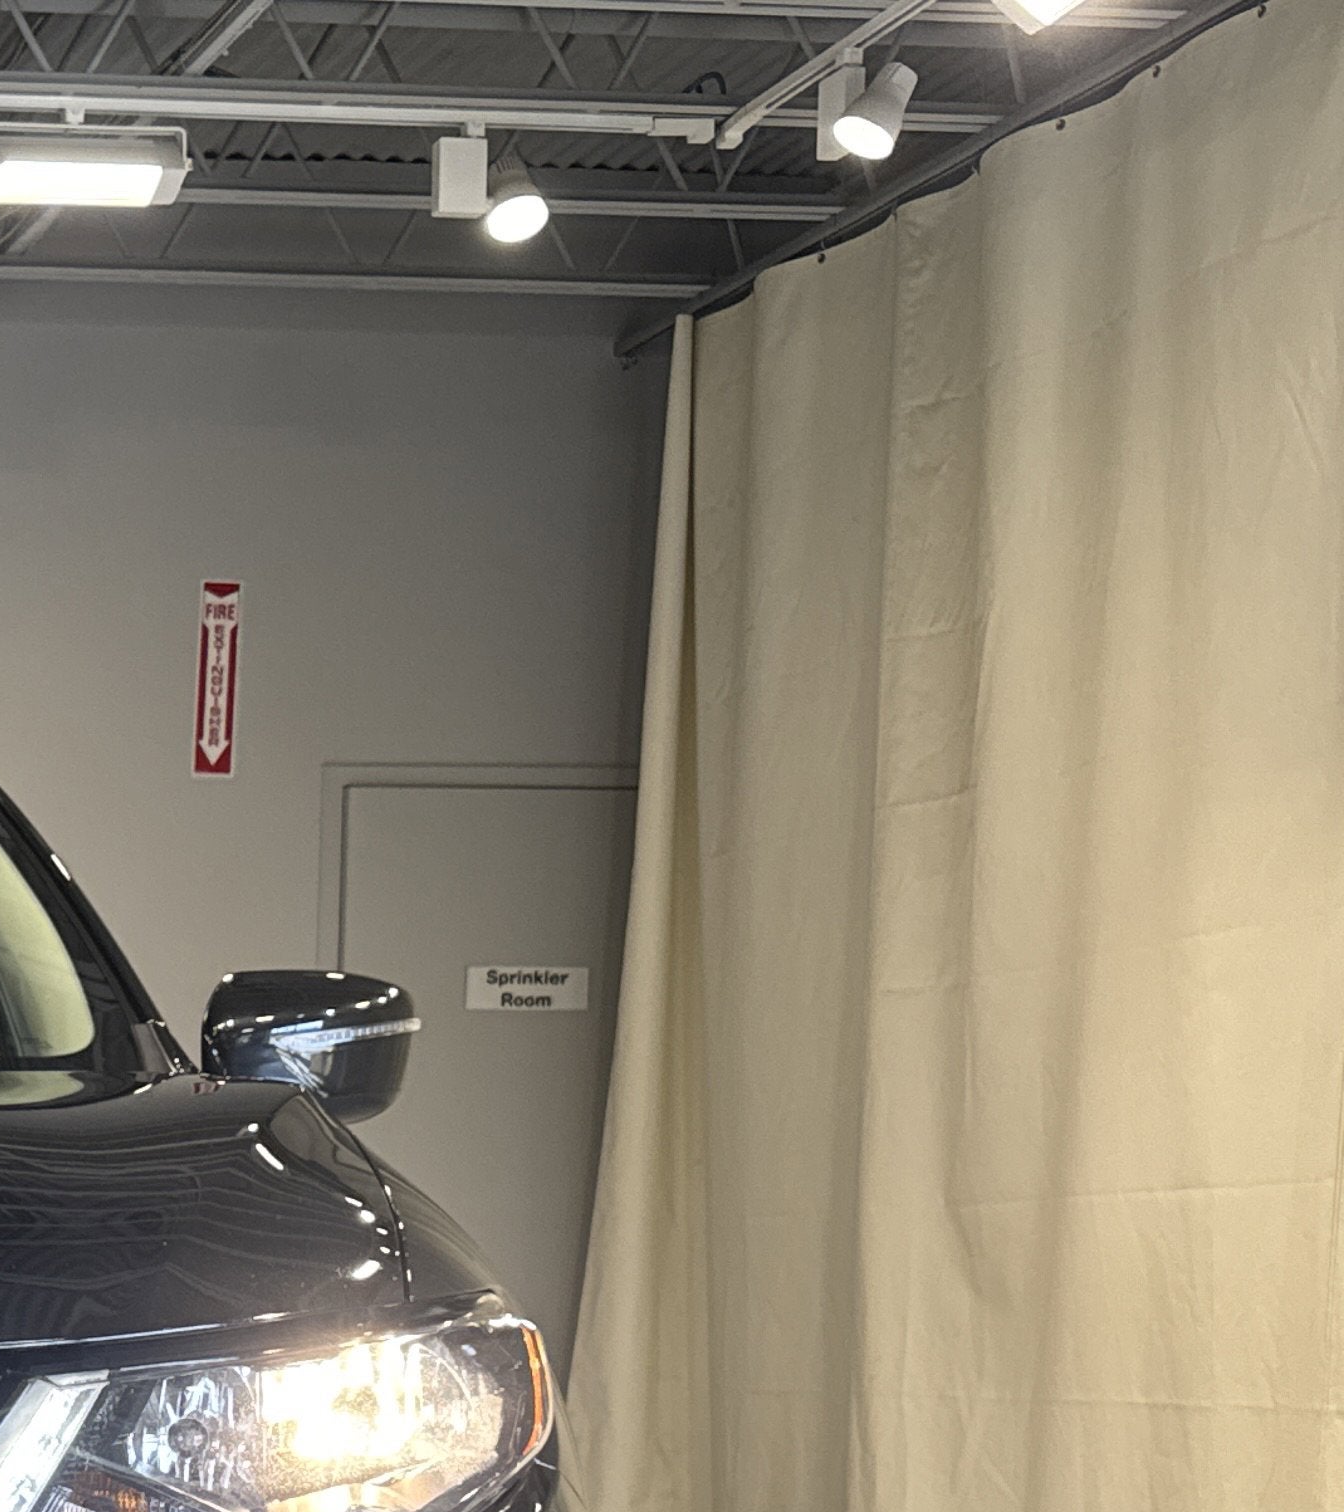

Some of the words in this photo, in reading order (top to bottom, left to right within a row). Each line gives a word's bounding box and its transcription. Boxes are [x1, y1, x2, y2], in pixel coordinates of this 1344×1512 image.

[205, 603, 235, 621] FIRE
[486, 969, 569, 987] Sprinkler
[501, 992, 552, 1007] Room
